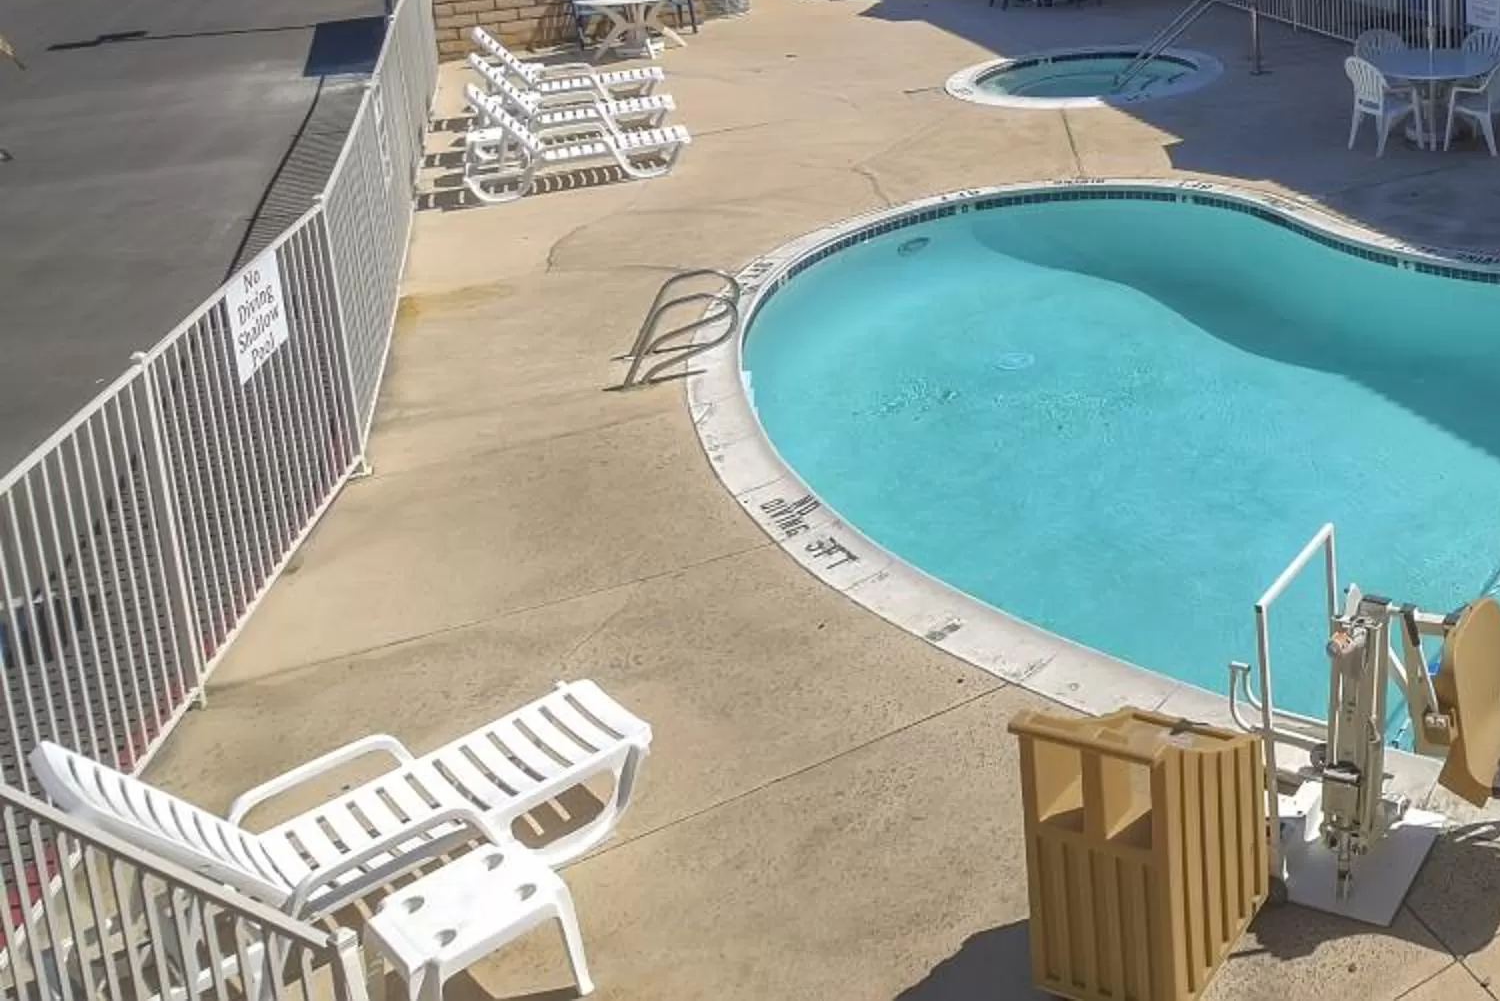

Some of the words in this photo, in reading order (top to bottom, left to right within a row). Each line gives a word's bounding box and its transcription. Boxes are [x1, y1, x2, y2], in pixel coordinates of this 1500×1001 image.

[243, 270, 261, 295] No
[236, 284, 276, 326] Diving
[237, 305, 280, 355] Shallow
[251, 331, 276, 369] Pool
